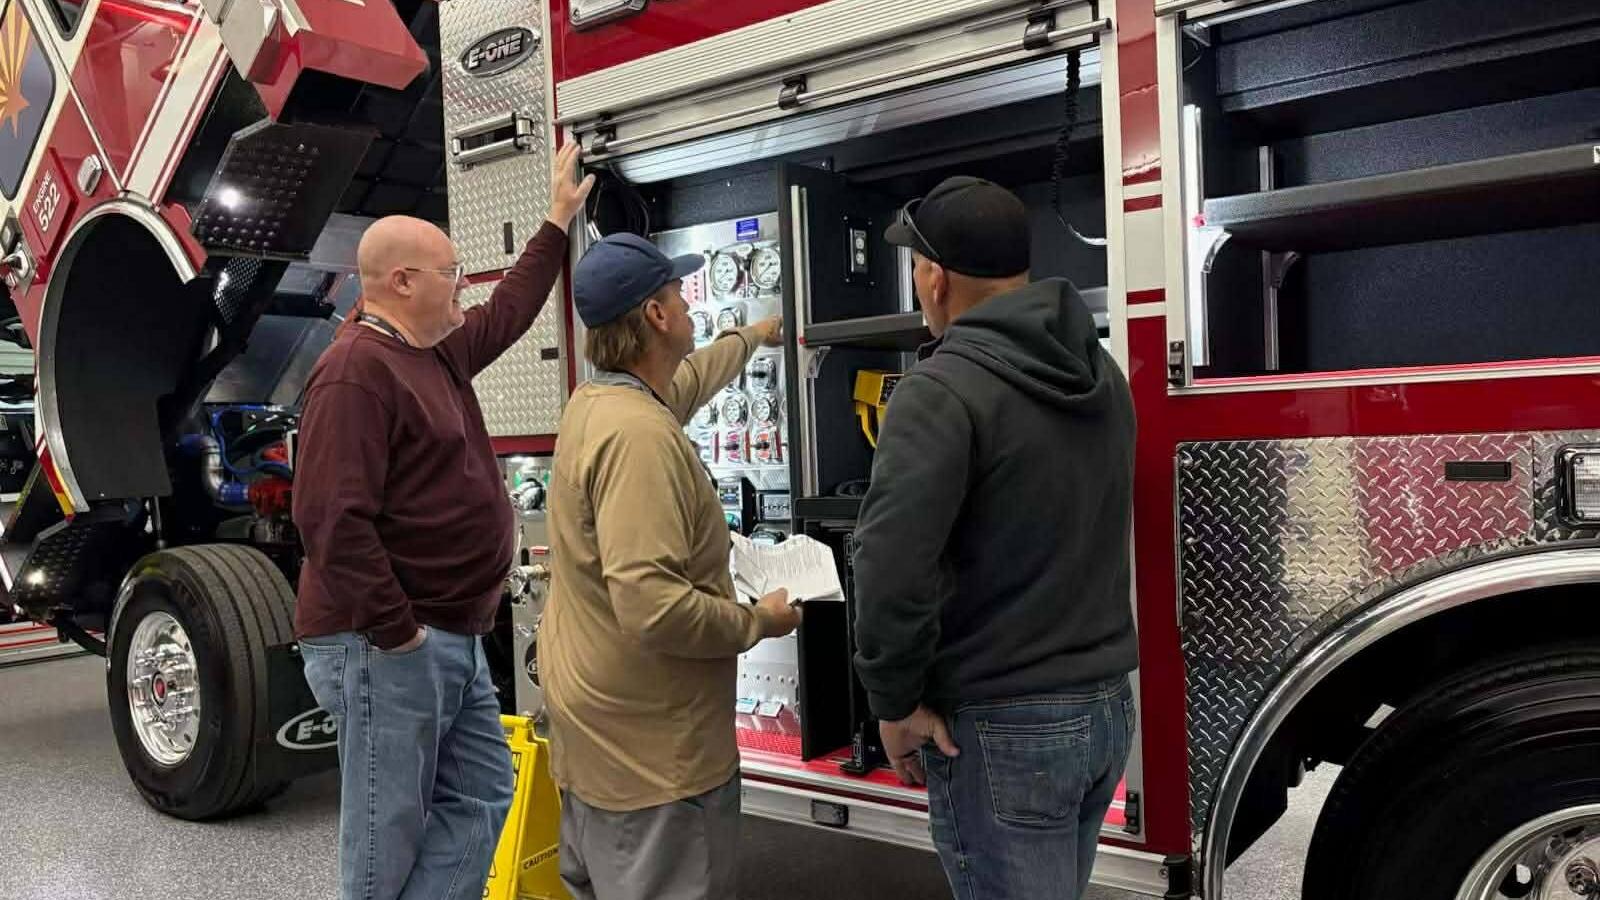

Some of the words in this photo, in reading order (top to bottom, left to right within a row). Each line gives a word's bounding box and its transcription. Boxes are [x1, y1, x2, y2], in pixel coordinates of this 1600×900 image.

[468, 32, 523, 68] E-ONE
[32, 169, 52, 213] ENGINE
[38, 182, 61, 232] 522
[523, 847, 559, 870] CAUTION
